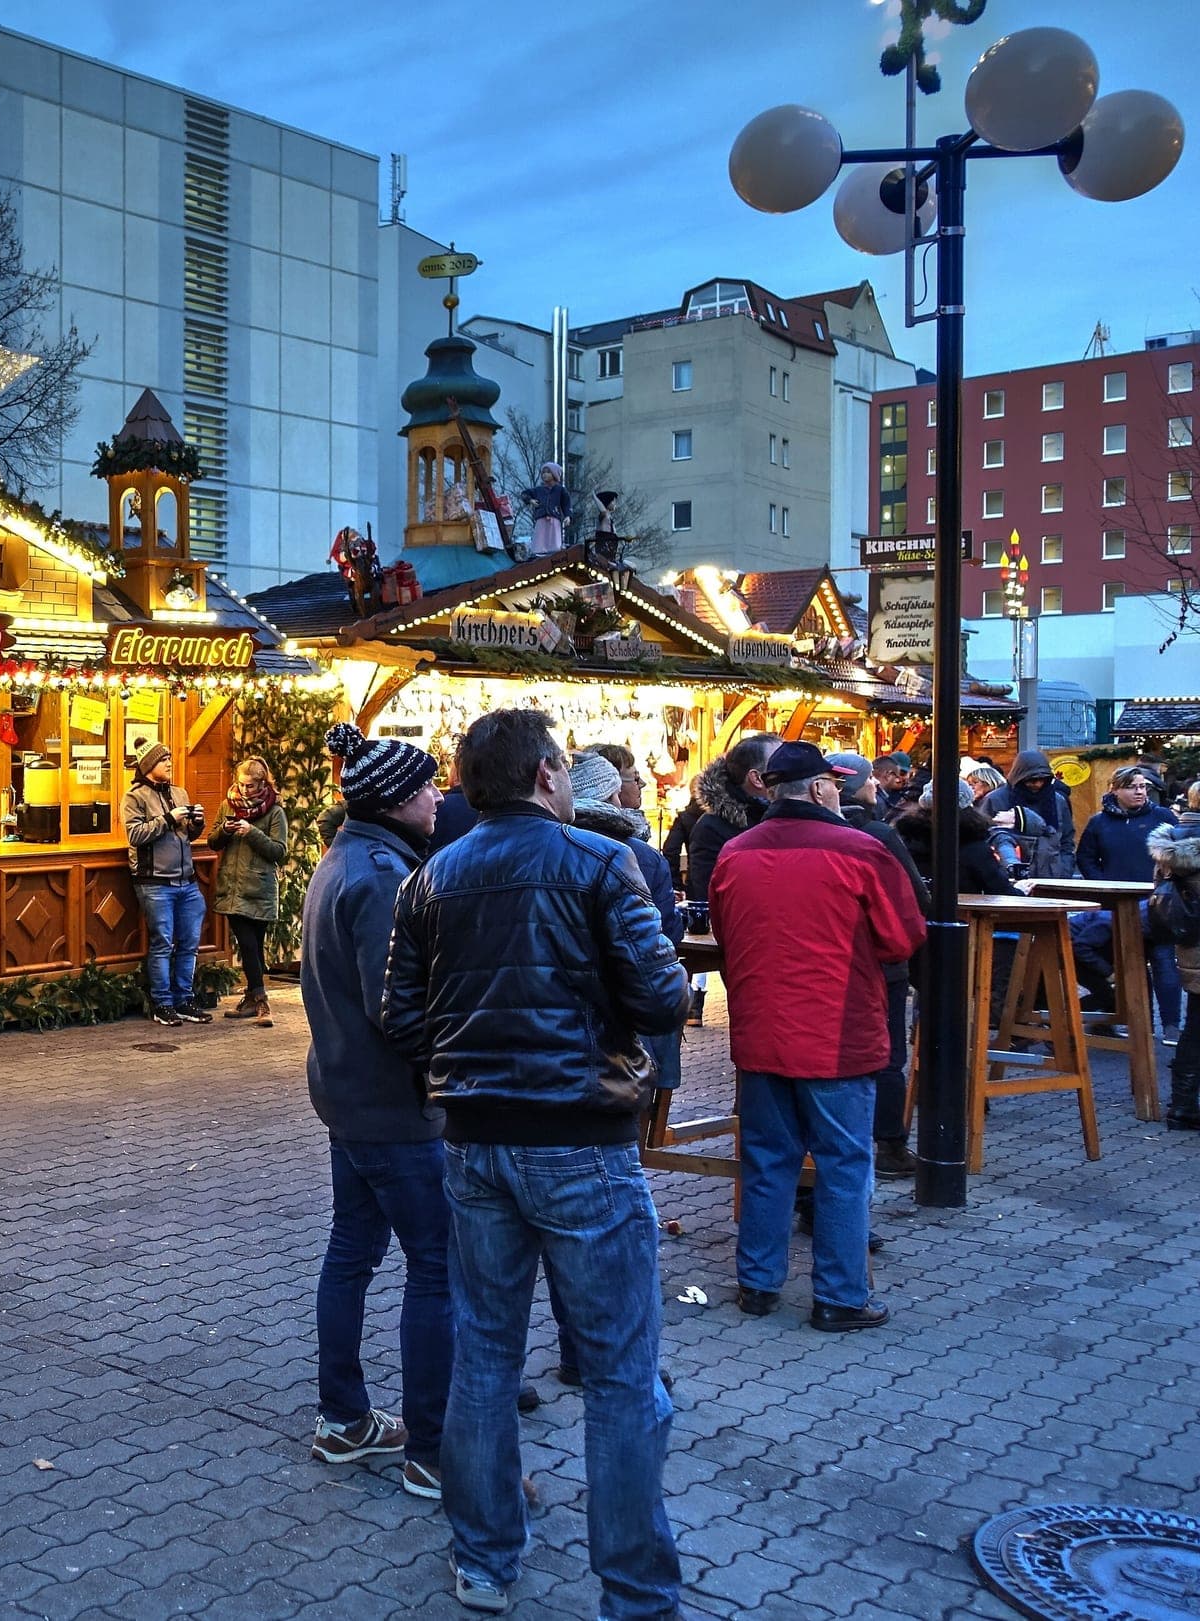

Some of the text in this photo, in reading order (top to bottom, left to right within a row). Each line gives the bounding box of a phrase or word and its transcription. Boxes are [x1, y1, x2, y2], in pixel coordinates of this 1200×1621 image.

[422, 259, 473, 272] anno 2012
[456, 613, 538, 647] Kirchner's
[111, 627, 254, 668] Eierpunsch
[733, 637, 788, 659] Alpenhaus
